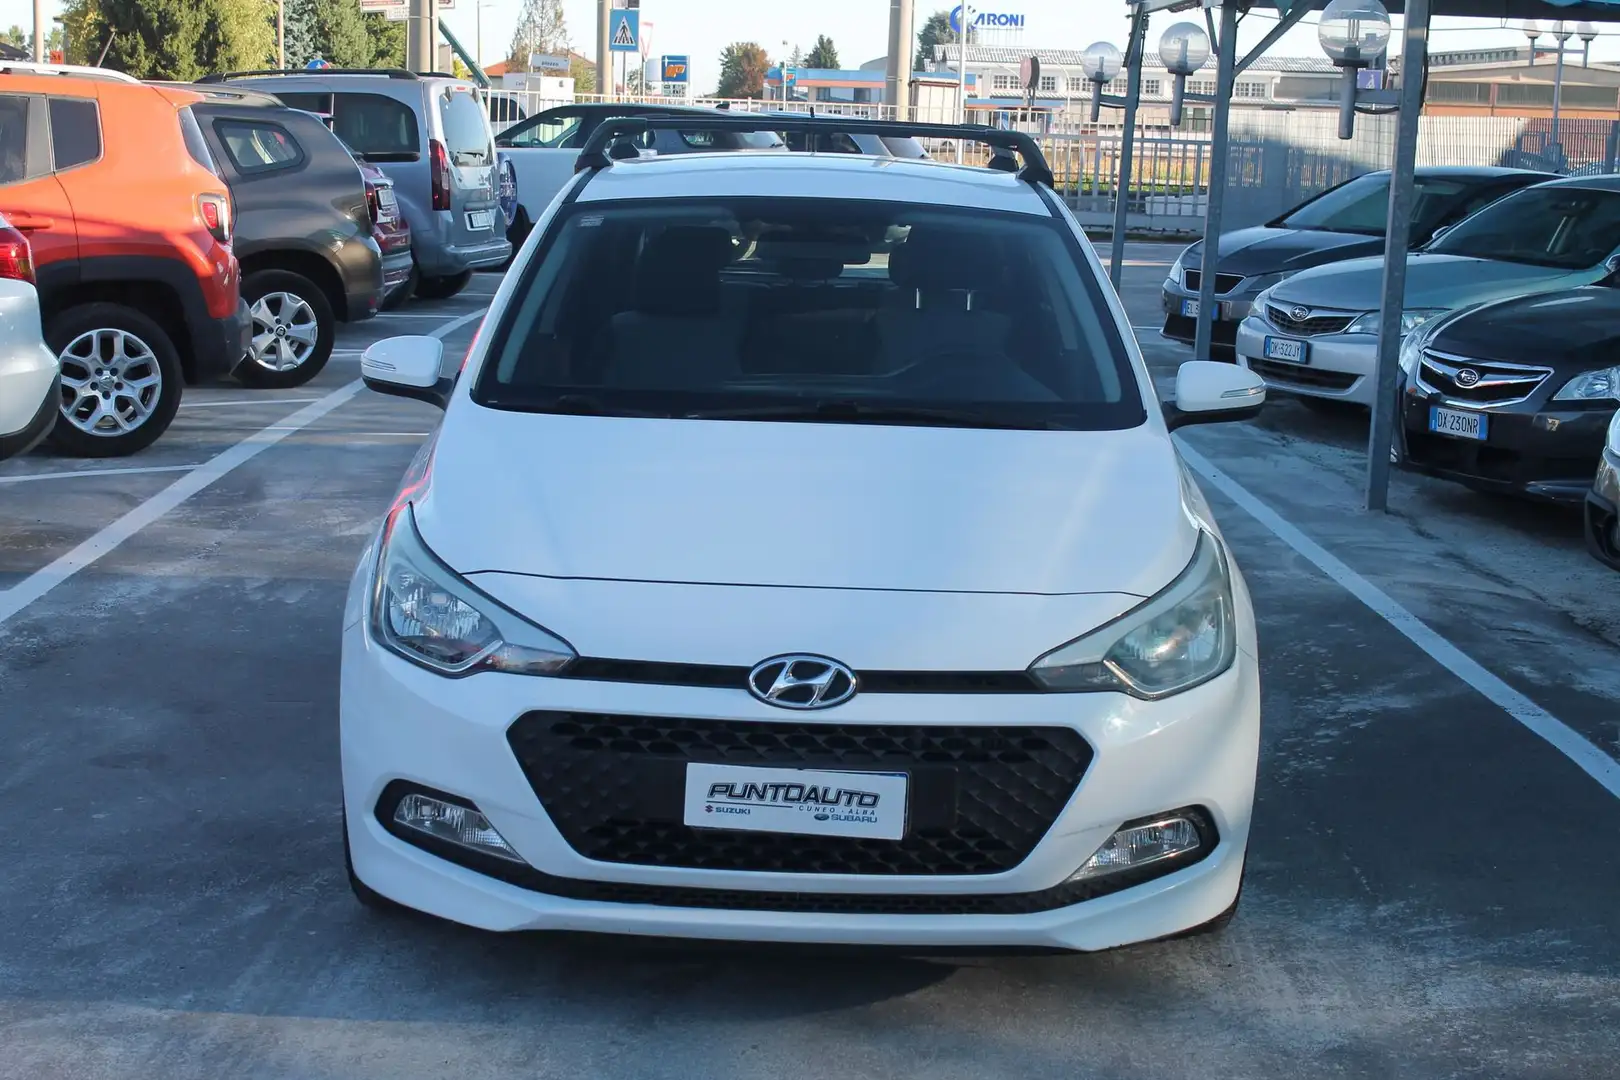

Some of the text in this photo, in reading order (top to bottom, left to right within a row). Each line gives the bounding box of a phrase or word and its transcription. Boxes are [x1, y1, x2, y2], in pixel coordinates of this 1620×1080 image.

[1450, 415, 1479, 434] 230NR
[707, 782, 880, 808] PUNTOAUTO
[715, 806, 751, 816] SUZUKI
[798, 805, 836, 813] CUNEO
[831, 814, 878, 823] SUBARU
